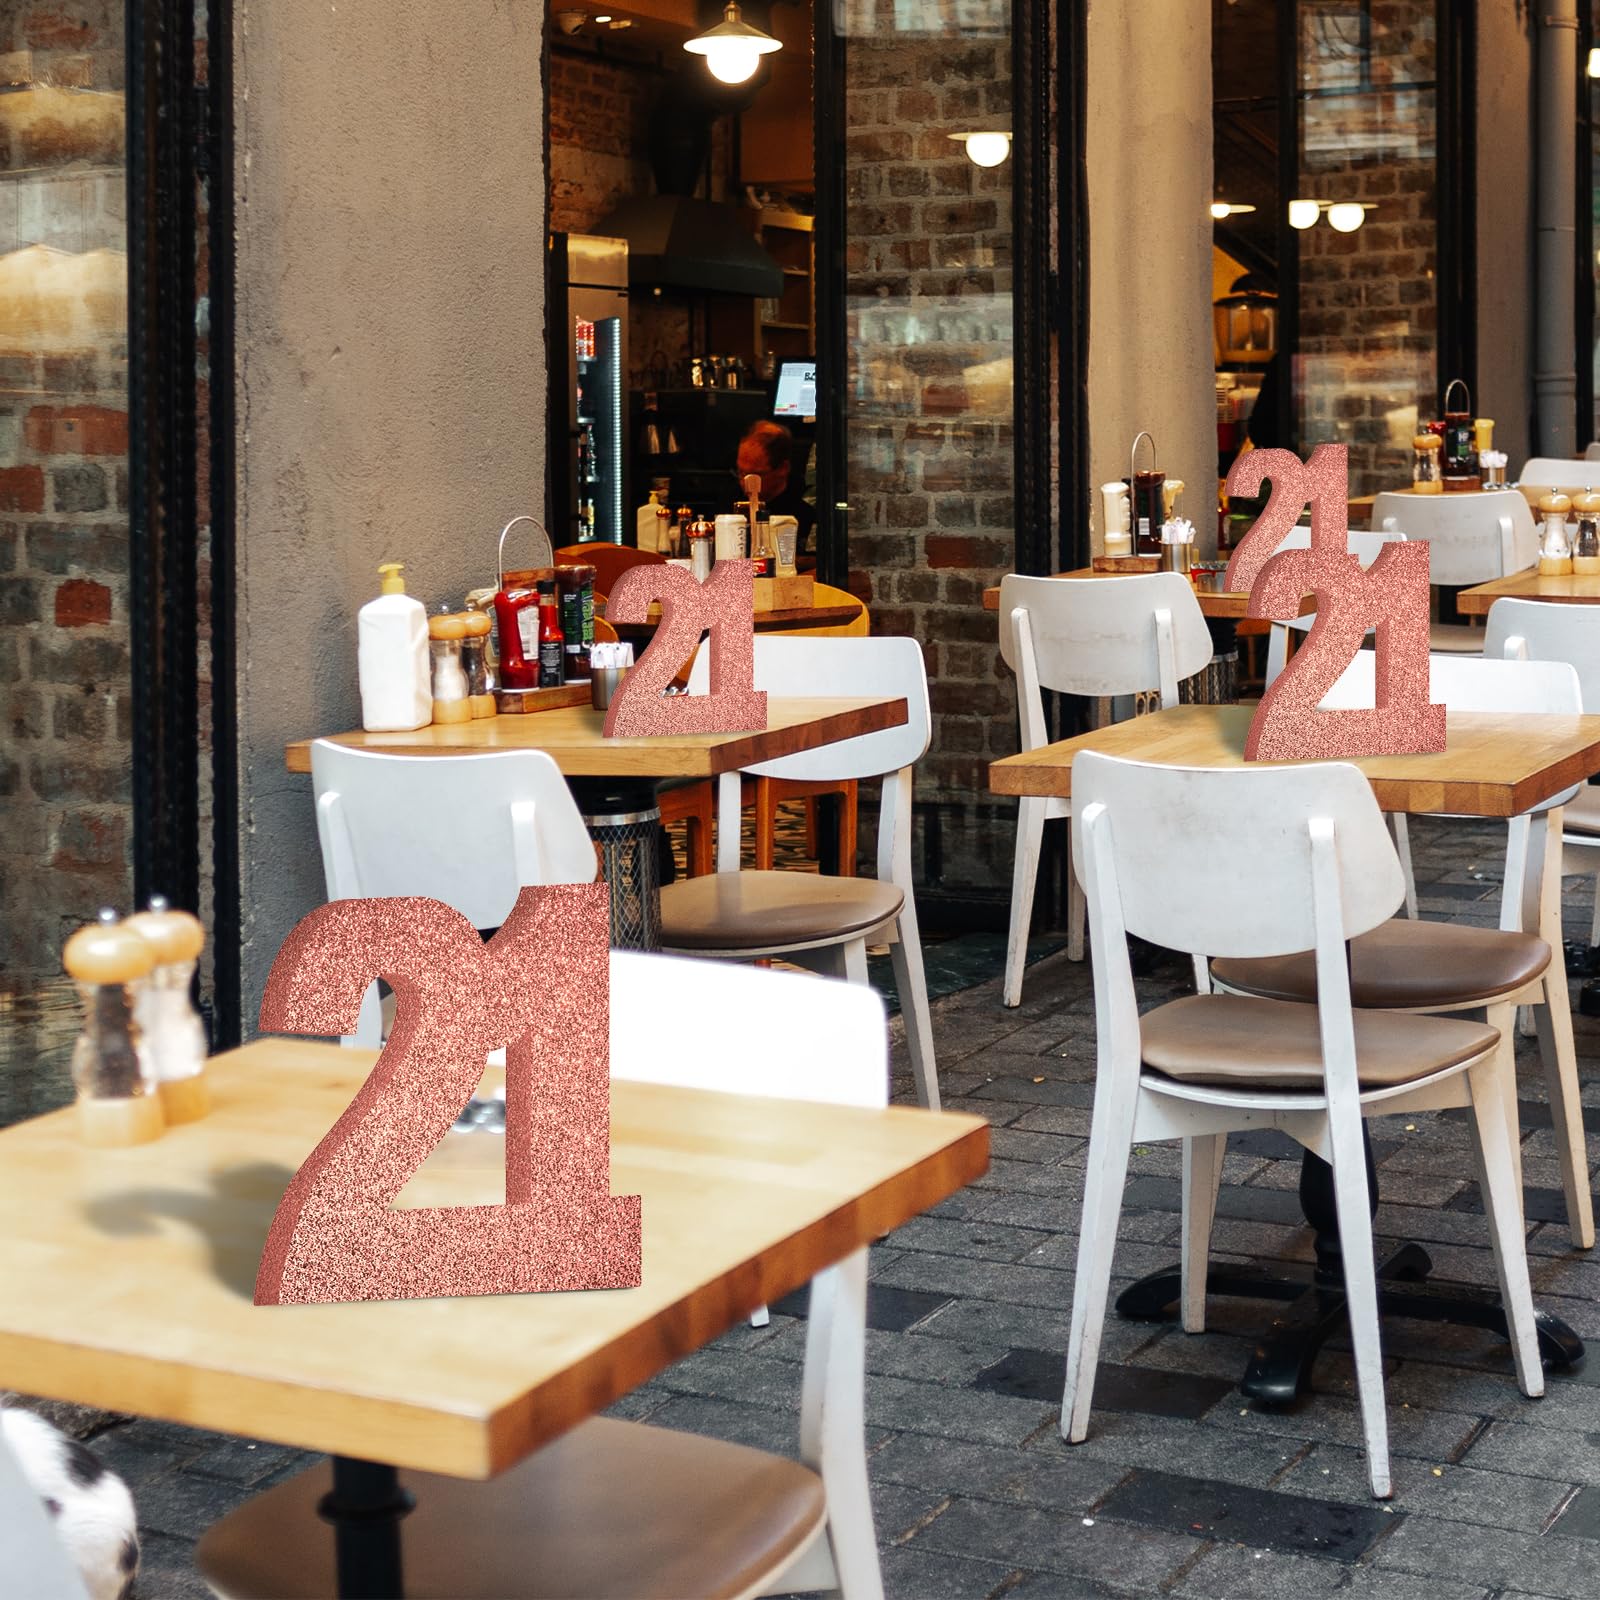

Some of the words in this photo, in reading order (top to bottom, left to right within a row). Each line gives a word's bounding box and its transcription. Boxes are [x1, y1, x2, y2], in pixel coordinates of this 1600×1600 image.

[1224, 444, 1359, 592] 21
[602, 560, 767, 737] 21
[1244, 541, 1447, 761] 21
[254, 883, 641, 1305] 21
